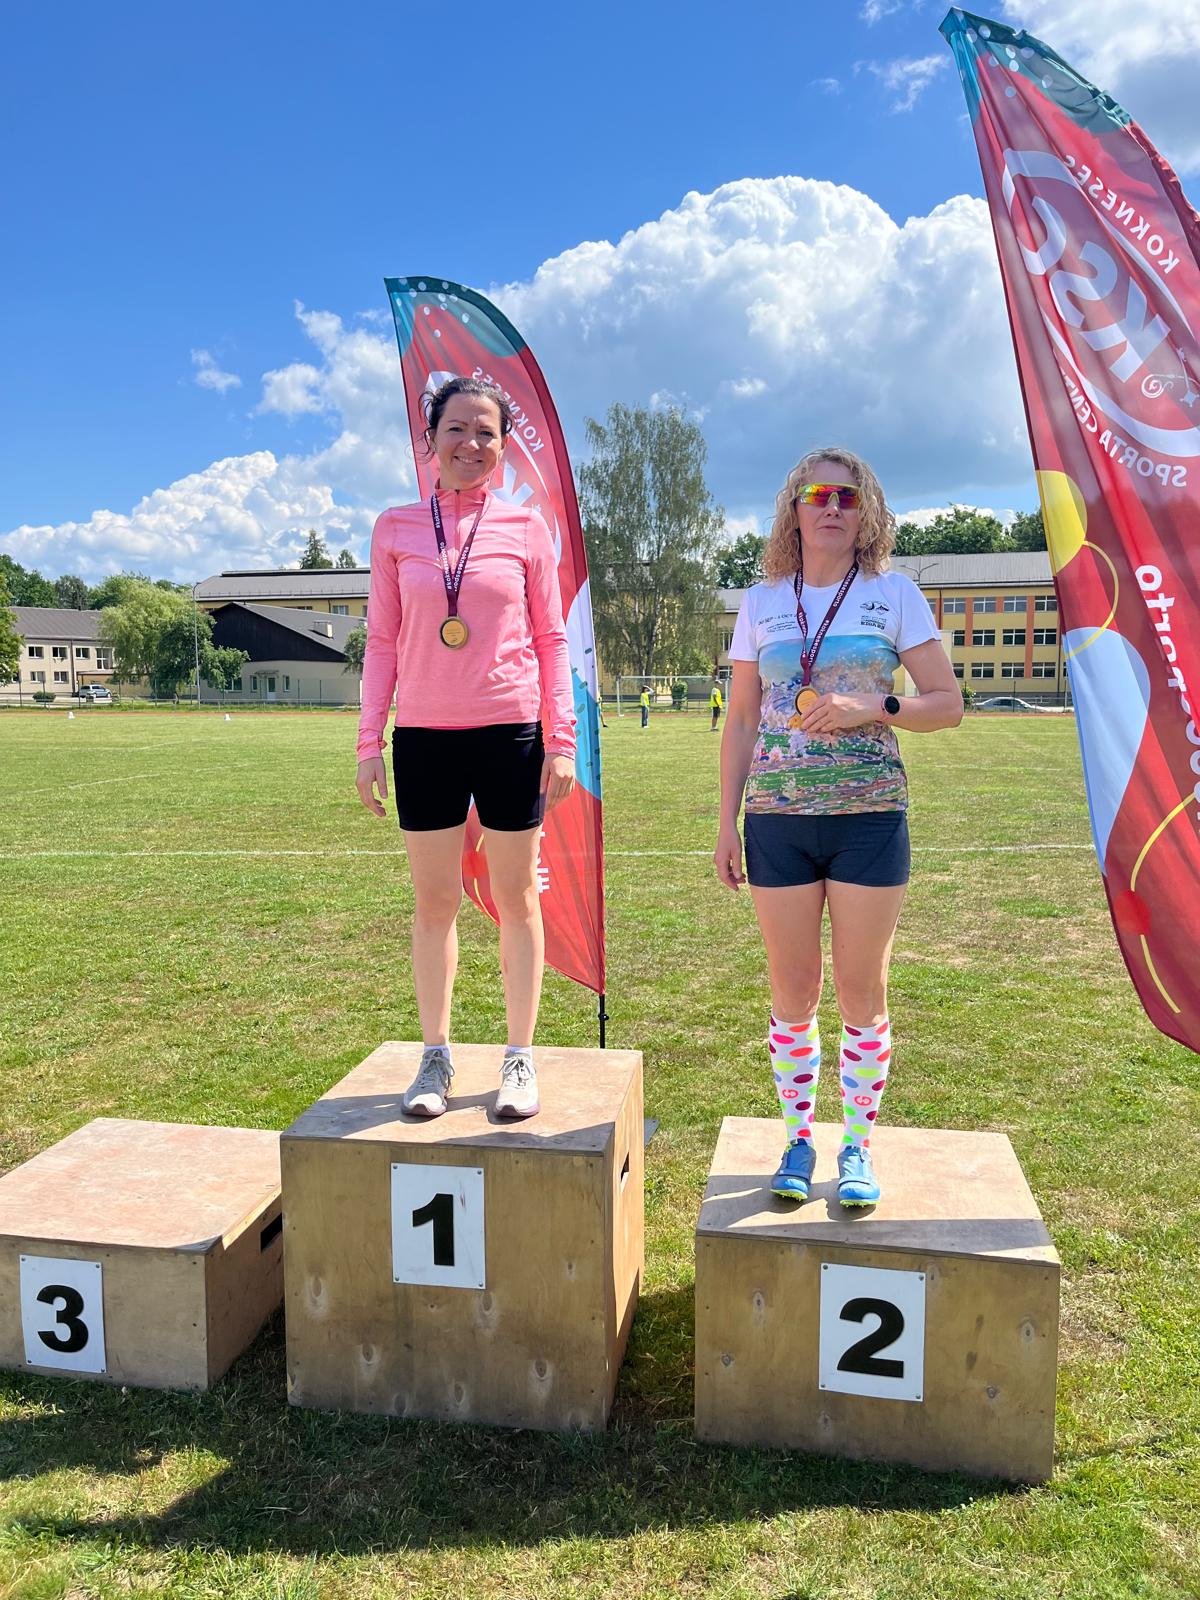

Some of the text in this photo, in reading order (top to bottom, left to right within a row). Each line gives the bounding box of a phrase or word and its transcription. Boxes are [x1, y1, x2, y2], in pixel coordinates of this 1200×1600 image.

[412, 1193, 456, 1267] 1
[36, 1284, 90, 1354] 3
[836, 1296, 905, 1379] 2
